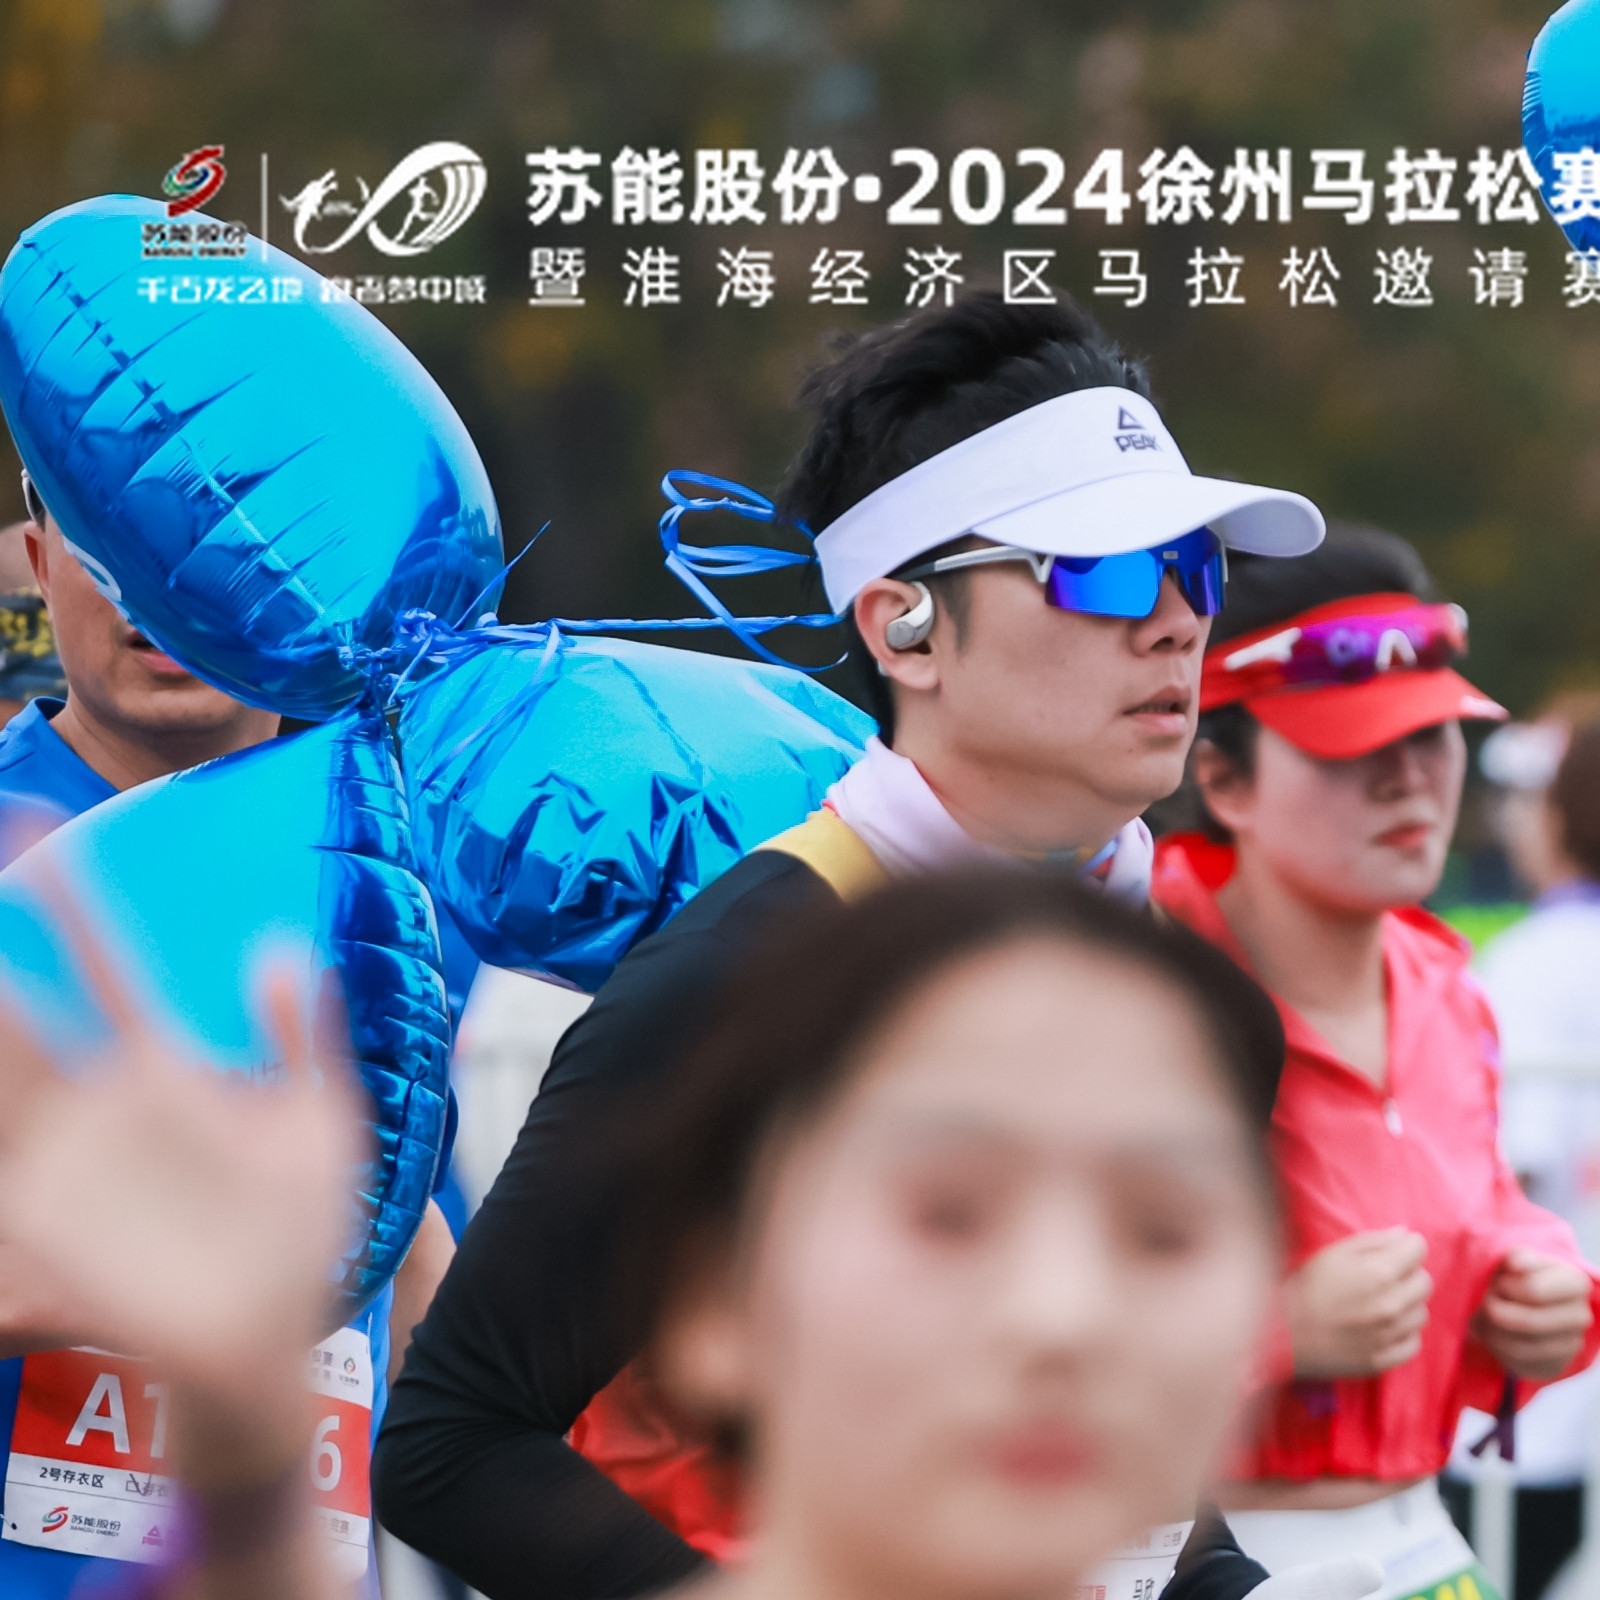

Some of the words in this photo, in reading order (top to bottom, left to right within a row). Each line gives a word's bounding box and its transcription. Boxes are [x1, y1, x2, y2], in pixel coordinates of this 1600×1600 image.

[39, 1466, 105, 1489] 2号存衣区
[70, 1514, 122, 1531] 苏能股份
